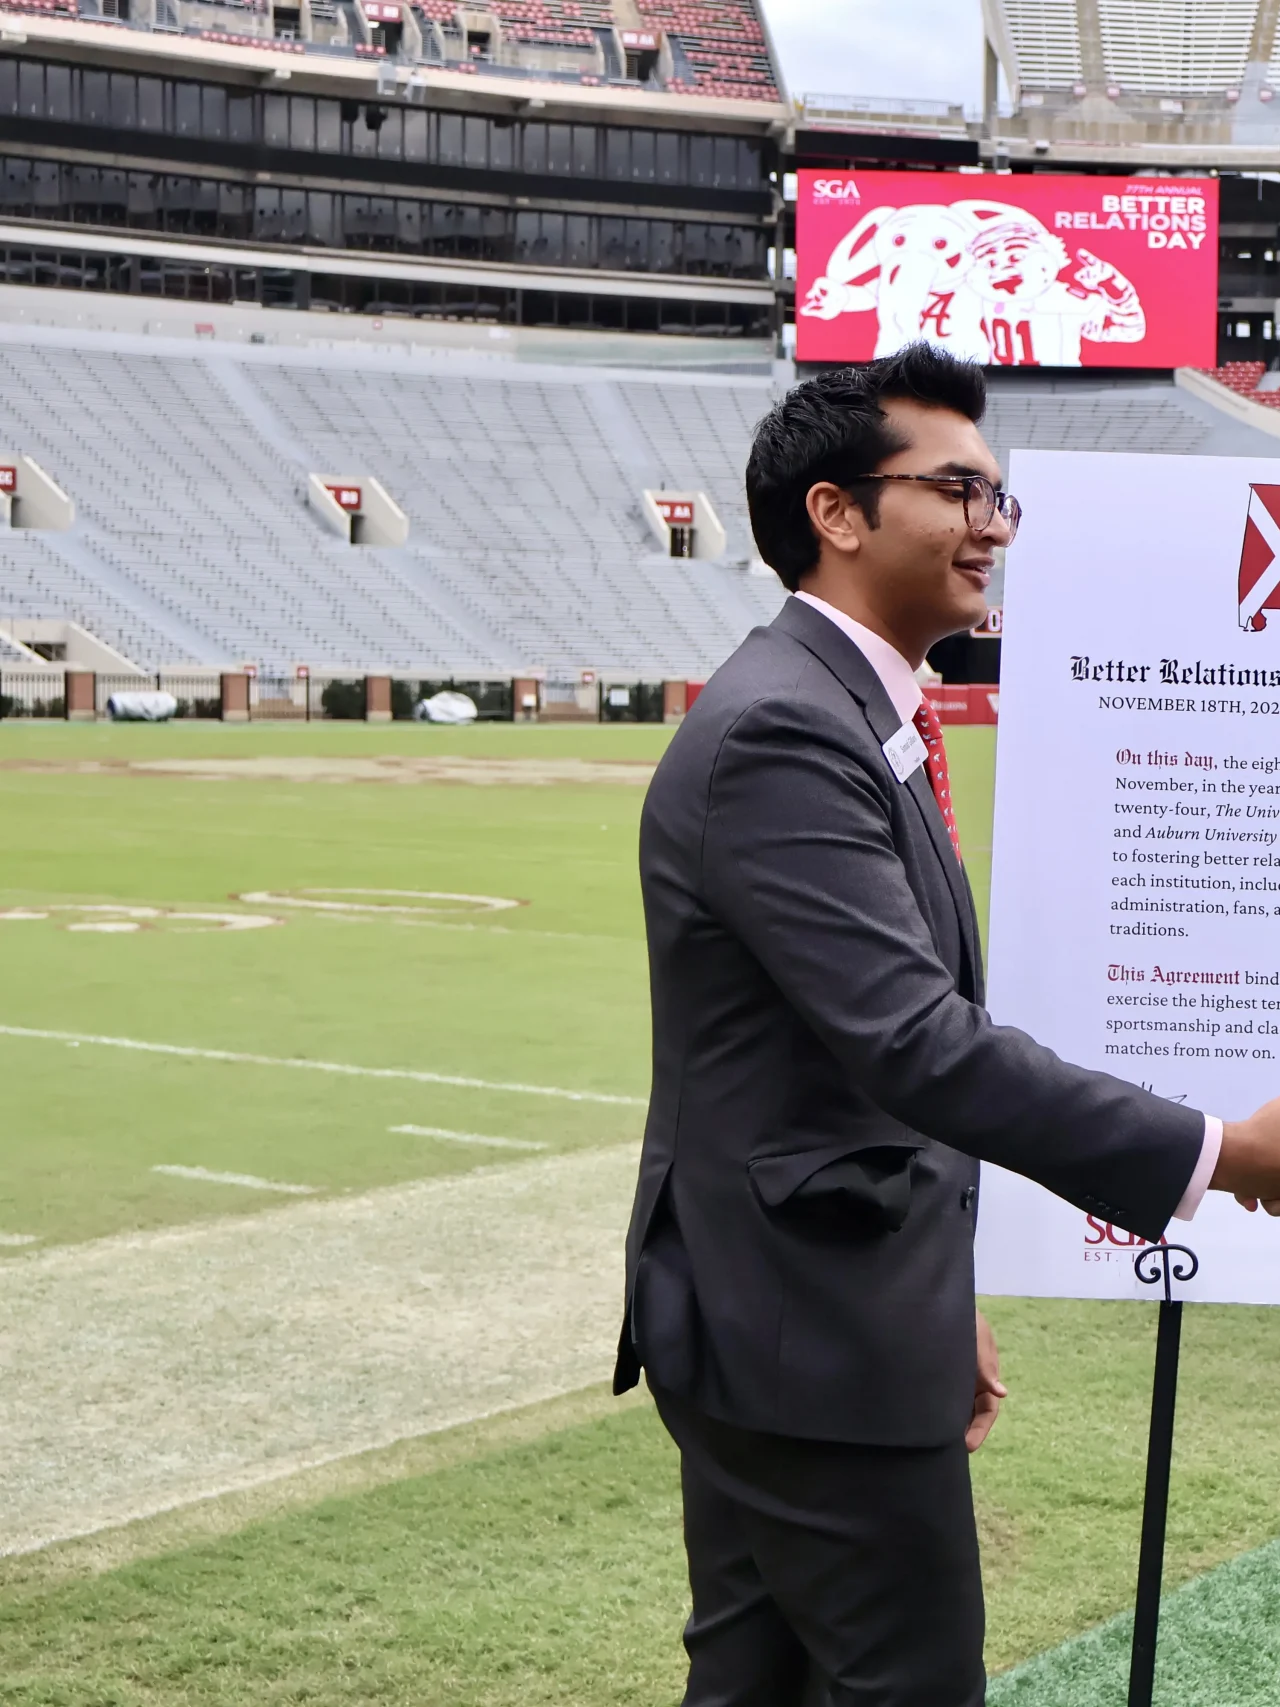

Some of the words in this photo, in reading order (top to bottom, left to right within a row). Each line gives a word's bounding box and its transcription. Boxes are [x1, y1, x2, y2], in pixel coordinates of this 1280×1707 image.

[813, 179, 861, 198] SGA
[1102, 195, 1205, 215] BETTER
[1054, 212, 1207, 232] RELATIONS
[1147, 232, 1206, 250] DAY
[1070, 656, 1151, 683] Better
[1099, 696, 1196, 712] NOVEMBER
[1201, 700, 1245, 716] 18TH,
[1116, 749, 1141, 765] On
[1147, 750, 1178, 769] this
[1184, 751, 1217, 771] day,
[1223, 756, 1247, 769] the
[1116, 778, 1197, 794] November,
[1202, 779, 1217, 792] in
[1221, 779, 1245, 793] the
[1249, 785, 1280, 797] year
[1114, 802, 1210, 819] twenty-four,
[1216, 804, 1241, 817] The
[1114, 825, 1141, 838] and
[1145, 826, 1199, 840] Auburn
[1205, 828, 1277, 846] University
[1113, 852, 1127, 862] to
[1132, 849, 1200, 868] fostering
[1204, 851, 1249, 865] better
[1112, 873, 1146, 886] each
[1150, 874, 1235, 892] institution,
[1111, 897, 1229, 916] administration,
[1233, 900, 1269, 918] fans,
[1110, 922, 1188, 937] traditions.
[1108, 964, 1144, 985] This
[1150, 966, 1240, 986] Agreement
[1107, 993, 1168, 1006] exercise
[1172, 993, 1196, 1007] the
[1201, 994, 1257, 1012] highest
[1106, 1018, 1220, 1036] sportsmanship
[1225, 1020, 1253, 1033] and
[1105, 1041, 1169, 1056] matches
[1174, 1042, 1210, 1057] from
[1214, 1048, 1248, 1058] now
[1252, 1049, 1275, 1059] on.
[1084, 1252, 1118, 1262] EST.
